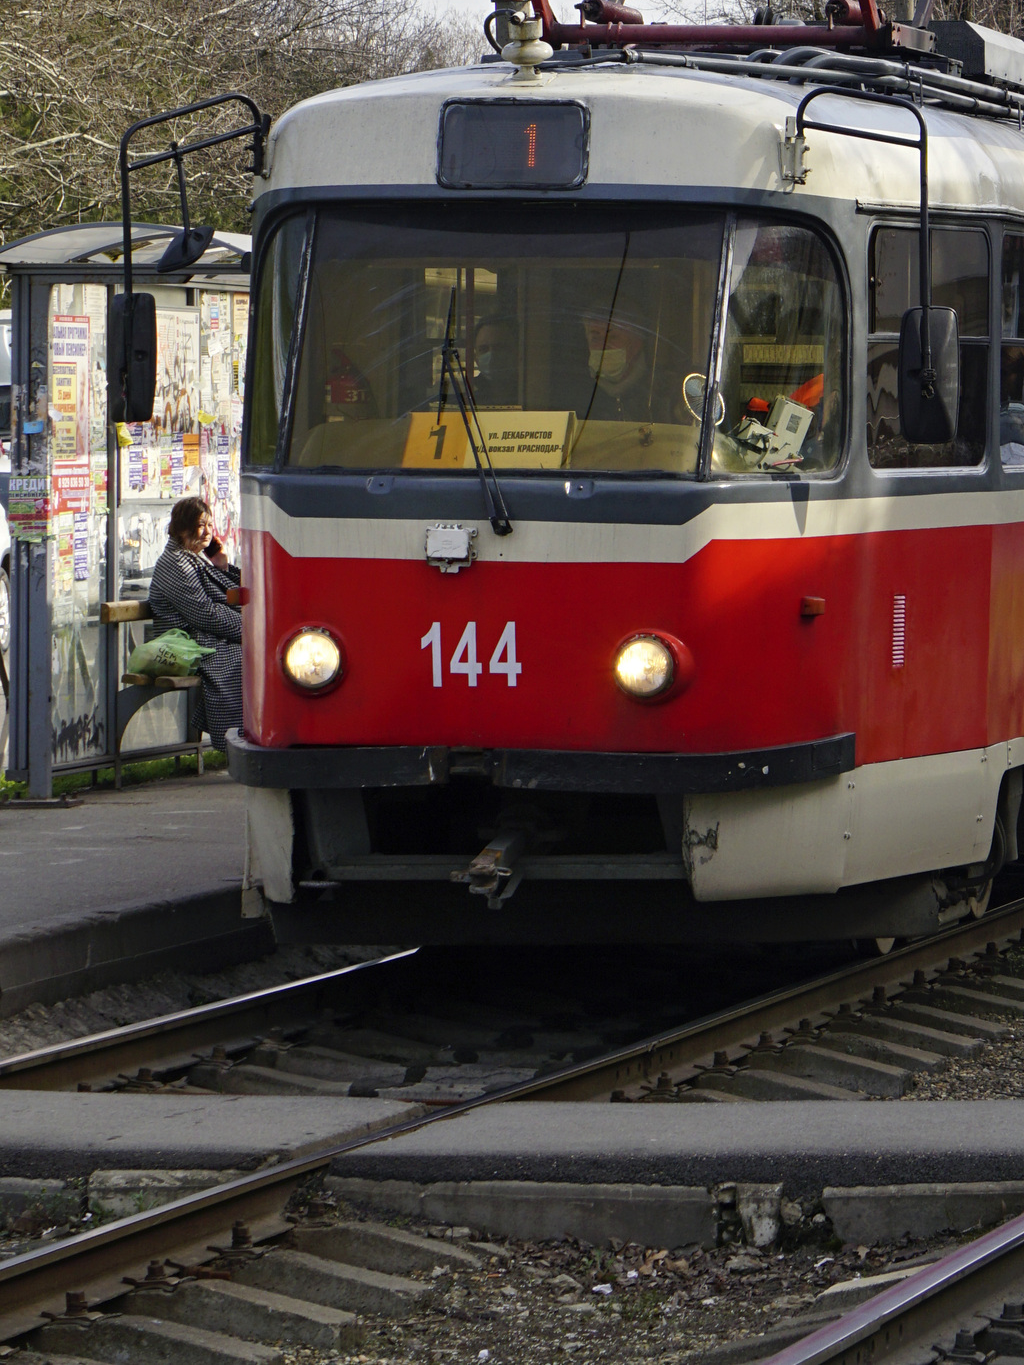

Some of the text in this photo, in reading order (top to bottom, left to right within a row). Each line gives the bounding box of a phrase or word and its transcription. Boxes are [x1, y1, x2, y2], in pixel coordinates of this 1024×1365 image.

[524, 123, 537, 167] 1
[429, 425, 447, 460] 1
[488, 431, 553, 440] ул. ДЕКАБРИСТОВ
[488, 445, 515, 453] вокзал
[9, 478, 50, 492] КРЕДИТ
[420, 621, 522, 688] 144
